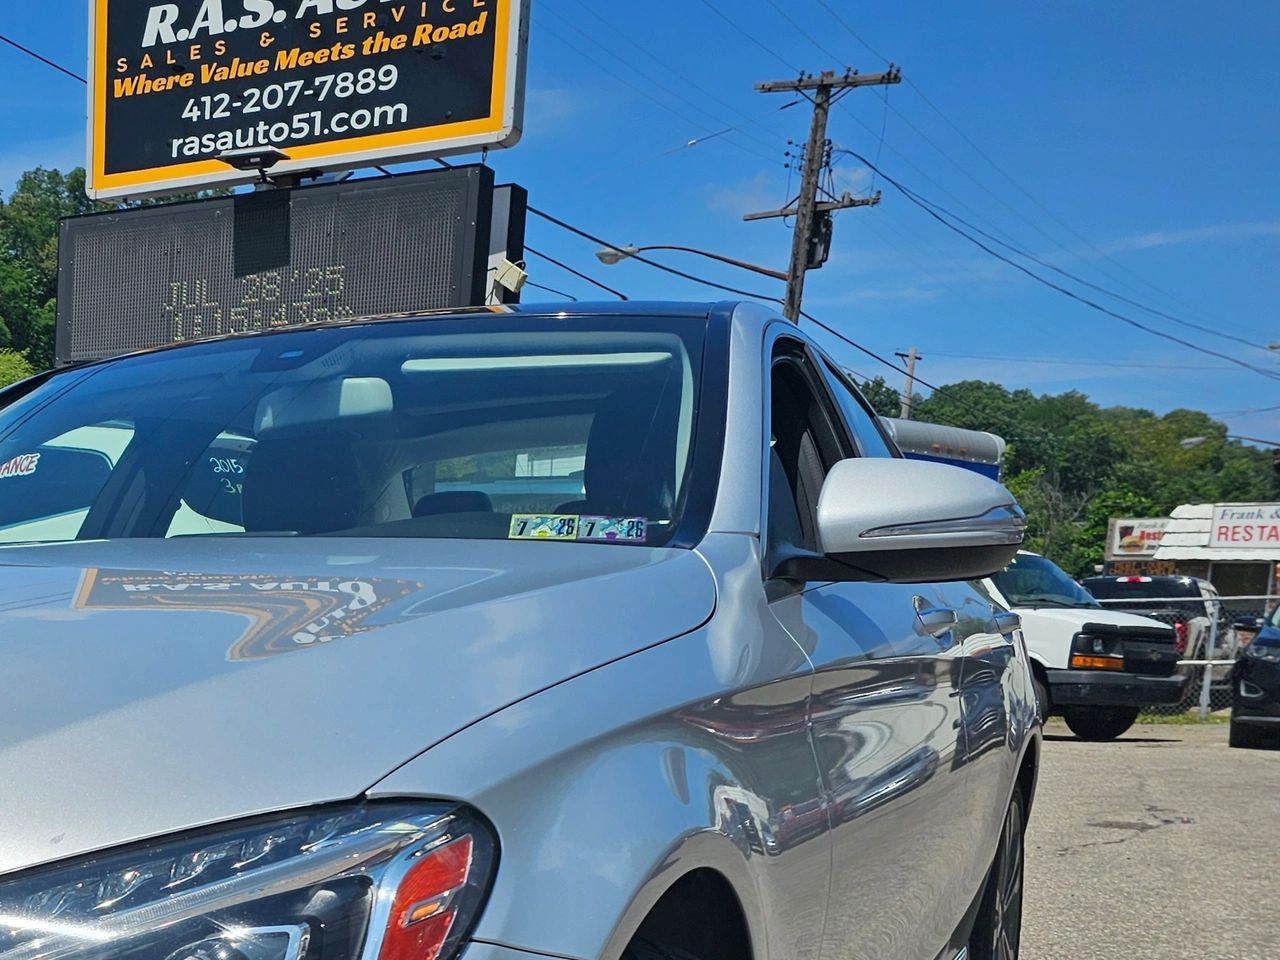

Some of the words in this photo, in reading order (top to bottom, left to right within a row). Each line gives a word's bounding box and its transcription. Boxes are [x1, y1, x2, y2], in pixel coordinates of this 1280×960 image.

[113, 72, 195, 98] Where
[200, 57, 269, 84] Value
[274, 42, 355, 71] Meets
[362, 31, 407, 56] the
[412, 11, 489, 47] Road
[116, 40, 226, 73] SALES
[260, 32, 275, 47] &
[181, 64, 398, 122] 412-207-7889
[171, 102, 408, 158] rasauto51.com
[163, 279, 219, 310] JUL
[241, 272, 281, 304] 28
[209, 457, 244, 473] 2015
[517, 521, 528, 536] 7
[557, 518, 575, 536] 26
[585, 522, 596, 536] 7
[627, 520, 644, 537] 26
[1220, 508, 1265, 520] Frank
